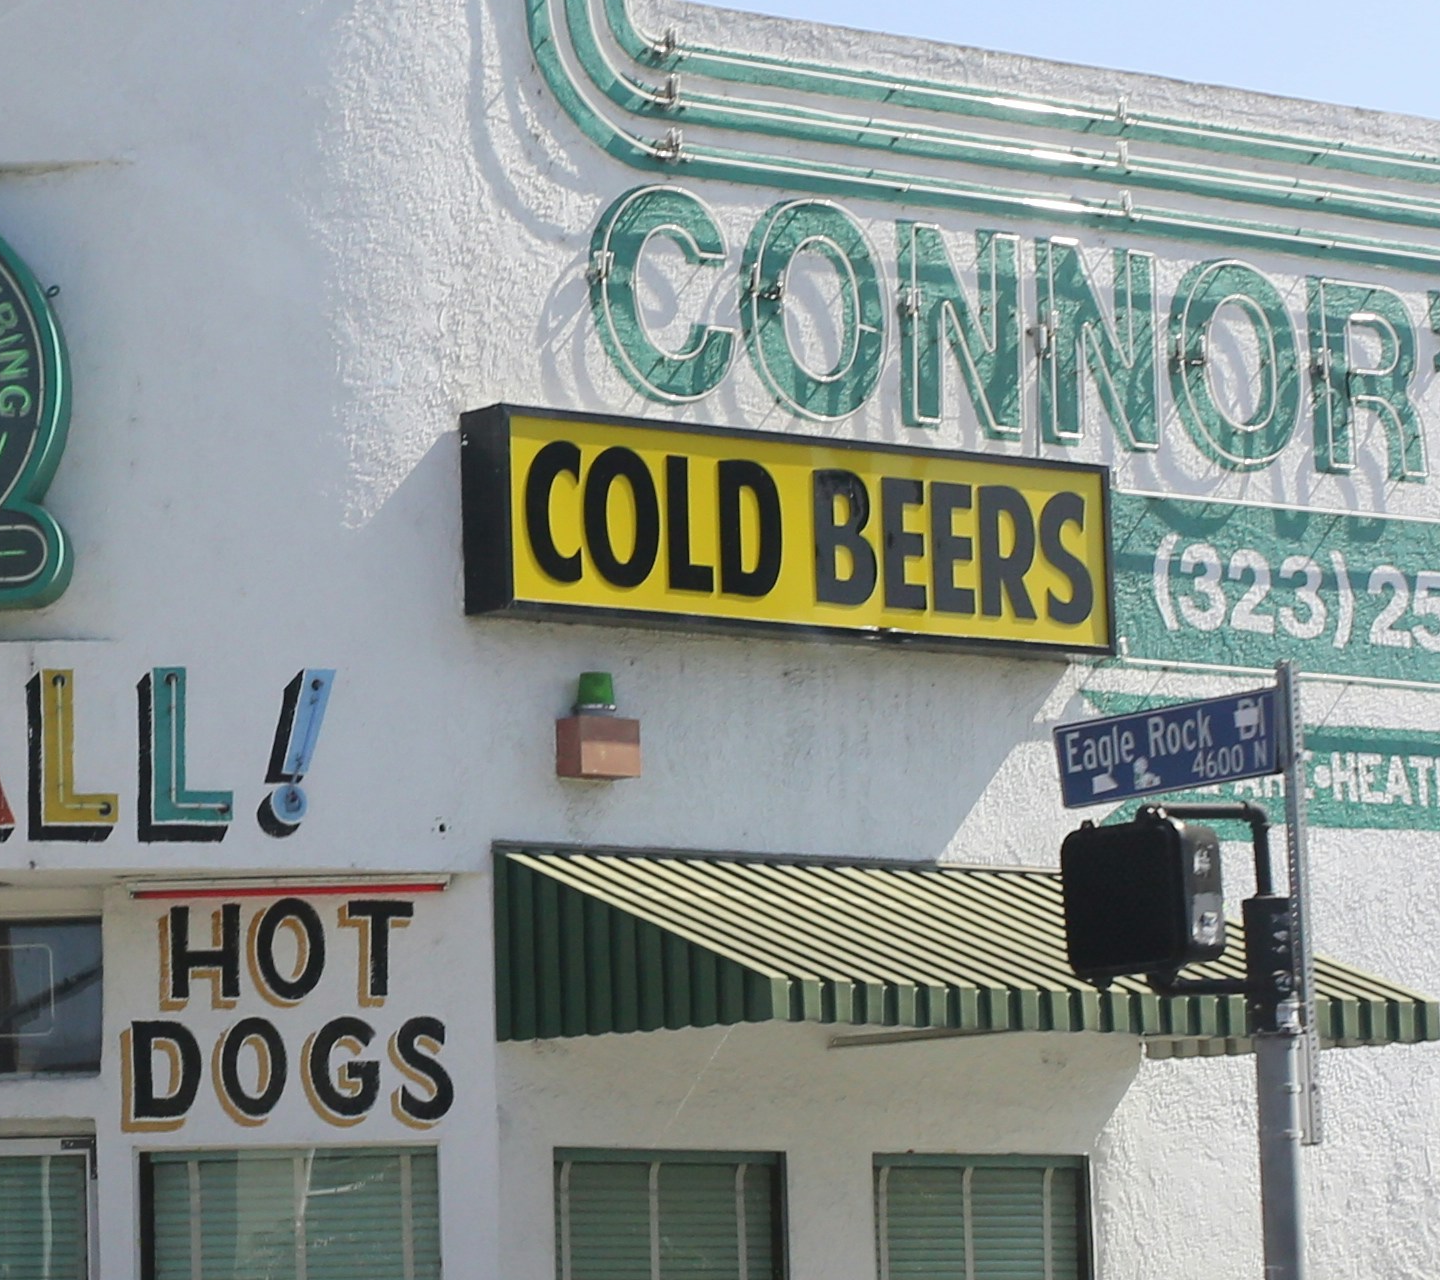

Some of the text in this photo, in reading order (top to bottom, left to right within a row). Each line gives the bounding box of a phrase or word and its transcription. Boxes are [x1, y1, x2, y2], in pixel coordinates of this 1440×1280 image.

[526, 441, 1094, 624] COLD BEERS
[1065, 724, 1136, 774] Eagle
[1147, 709, 1213, 758] Rock
[1191, 745, 1244, 780] 4600
[1253, 739, 1268, 770] N
[158, 896, 418, 1011] HOT
[121, 1014, 455, 1134] DOGS
